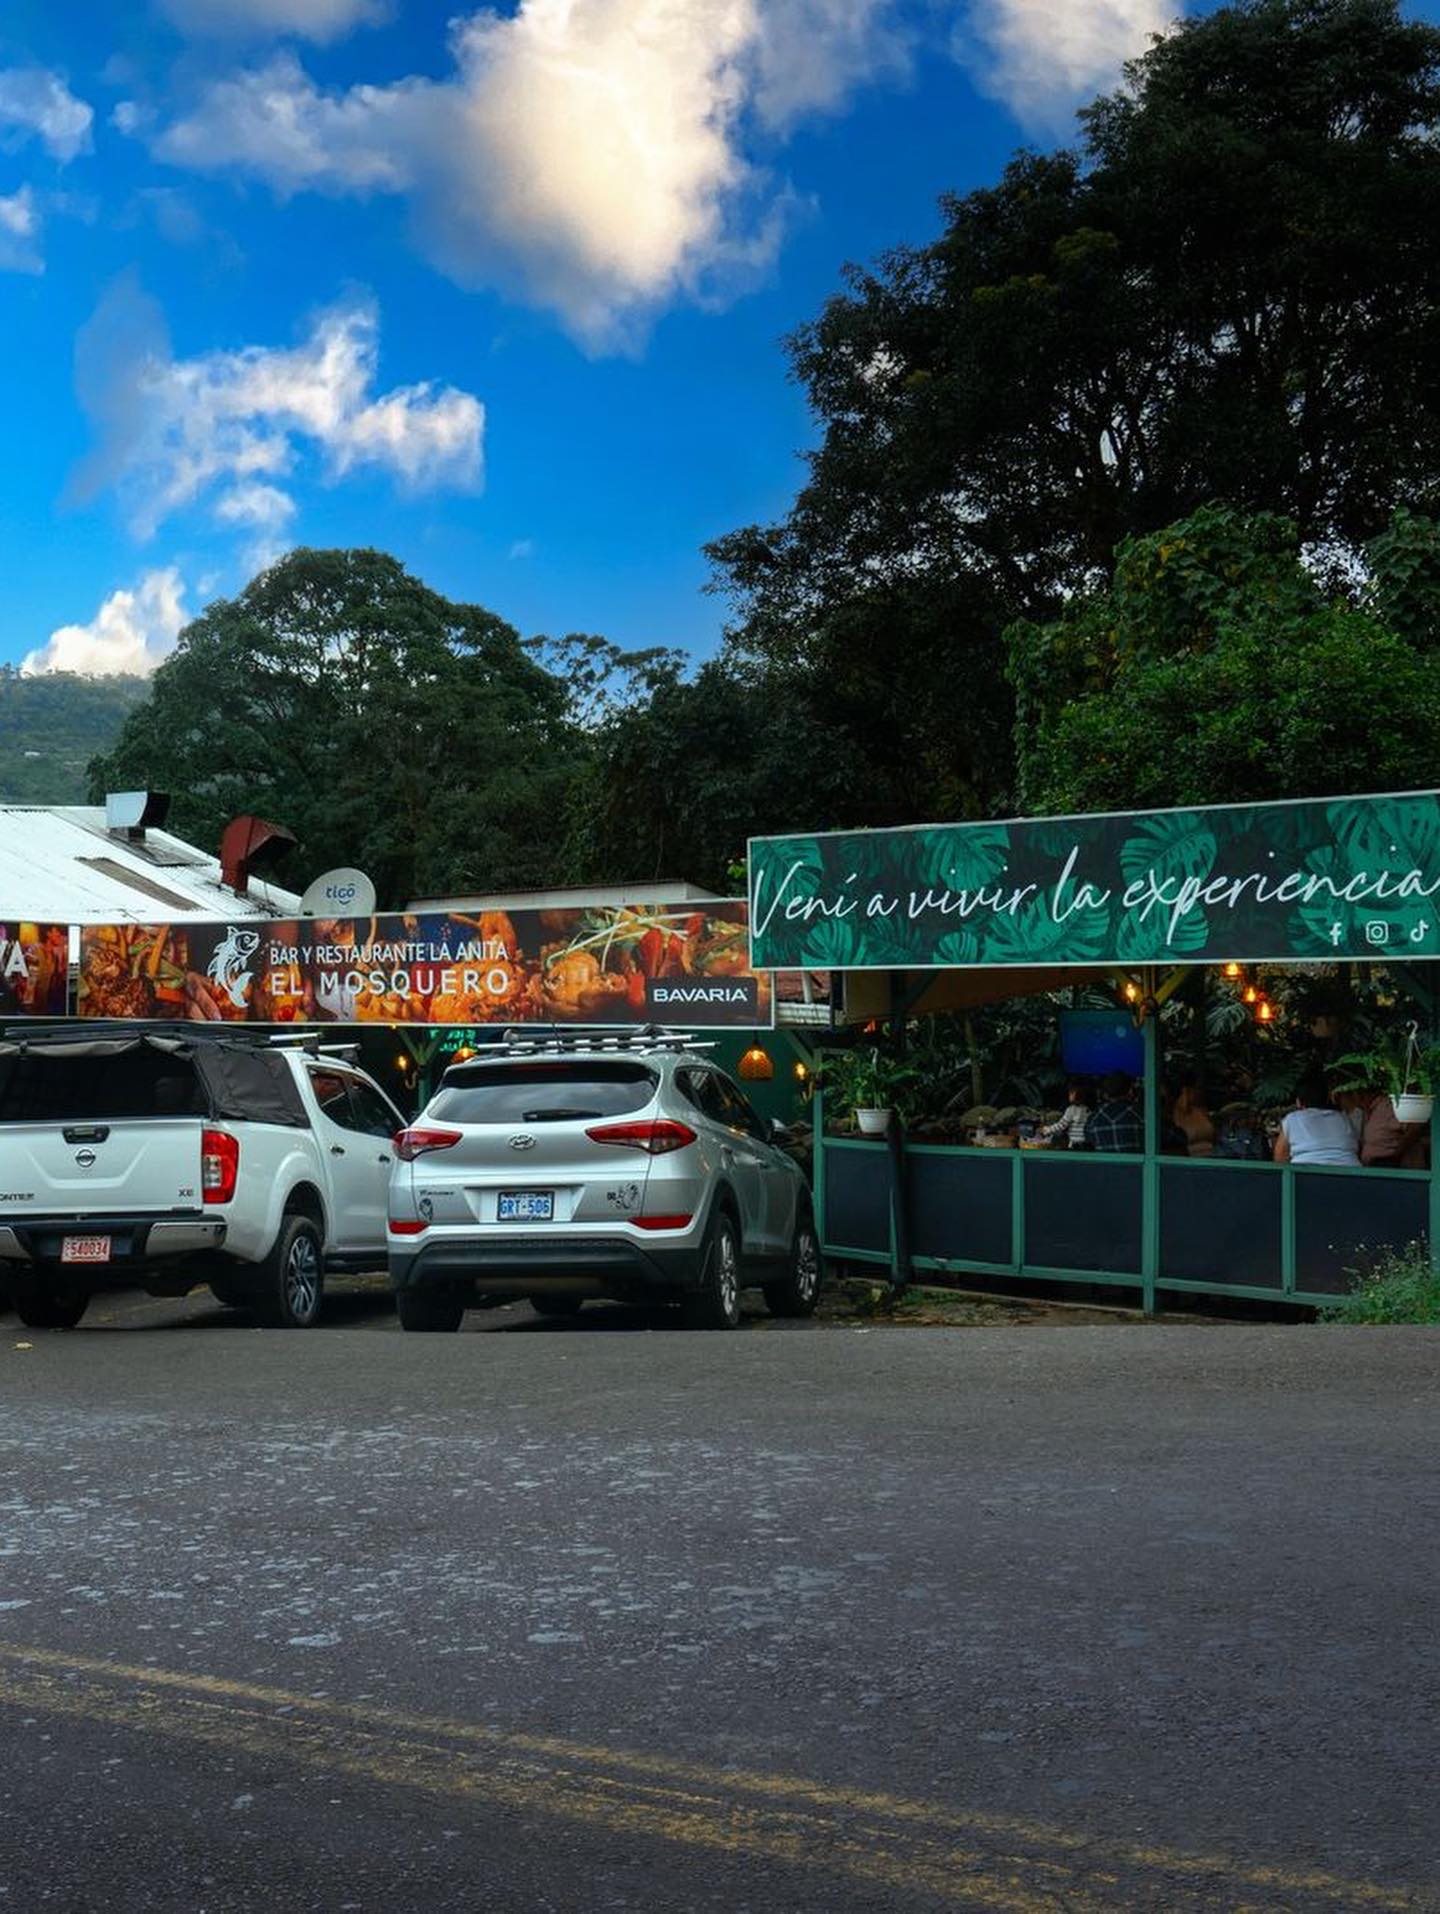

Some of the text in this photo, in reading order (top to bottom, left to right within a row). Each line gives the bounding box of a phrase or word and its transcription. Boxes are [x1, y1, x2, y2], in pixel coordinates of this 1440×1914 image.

[752, 845, 1440, 946] Vení a vivir la experiencia
[270, 940, 508, 965] BAR Y RESTAURANTE LA ANITA
[271, 967, 509, 1000] EL MOSQUERO
[652, 987, 748, 1002] BAVARIA
